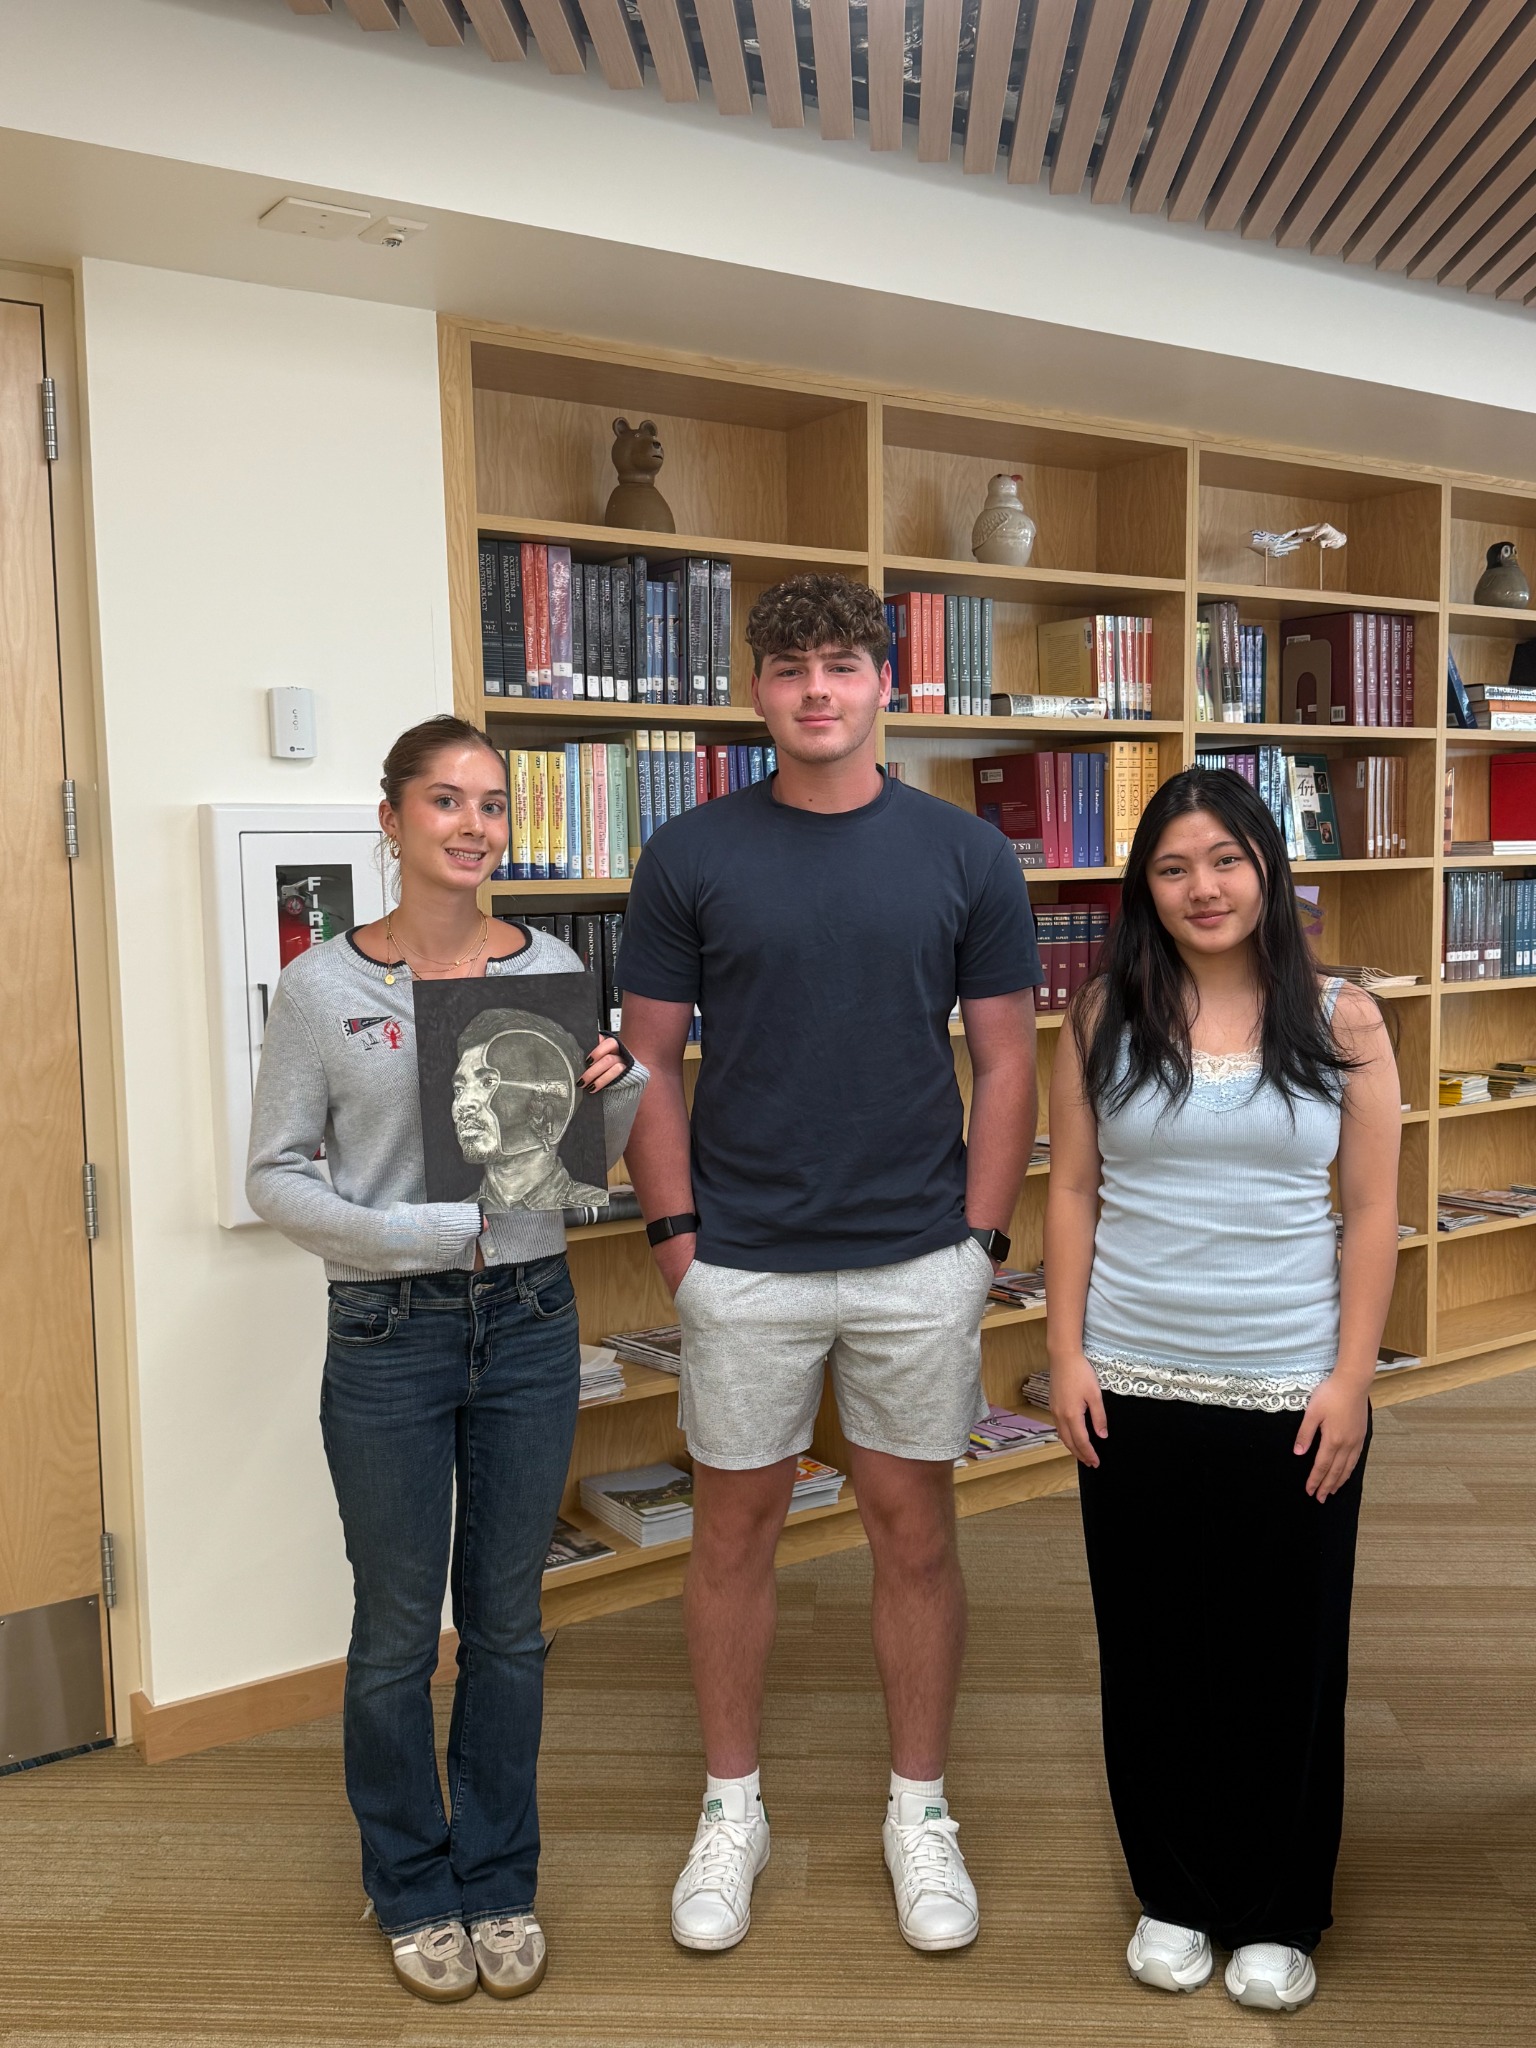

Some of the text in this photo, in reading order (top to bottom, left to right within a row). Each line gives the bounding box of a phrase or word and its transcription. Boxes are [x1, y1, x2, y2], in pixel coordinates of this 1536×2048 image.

[479, 553, 488, 612] PARAPSYCHOLOGY
[485, 554, 493, 590] OCCULTISM
[503, 555, 511, 613] PARAPSYCHOLOGY
[654, 776, 661, 784] &
[669, 776, 676, 784] &
[684, 776, 690, 784] &
[1298, 779, 1314, 796] Art
[308, 877, 324, 943] FIRE
